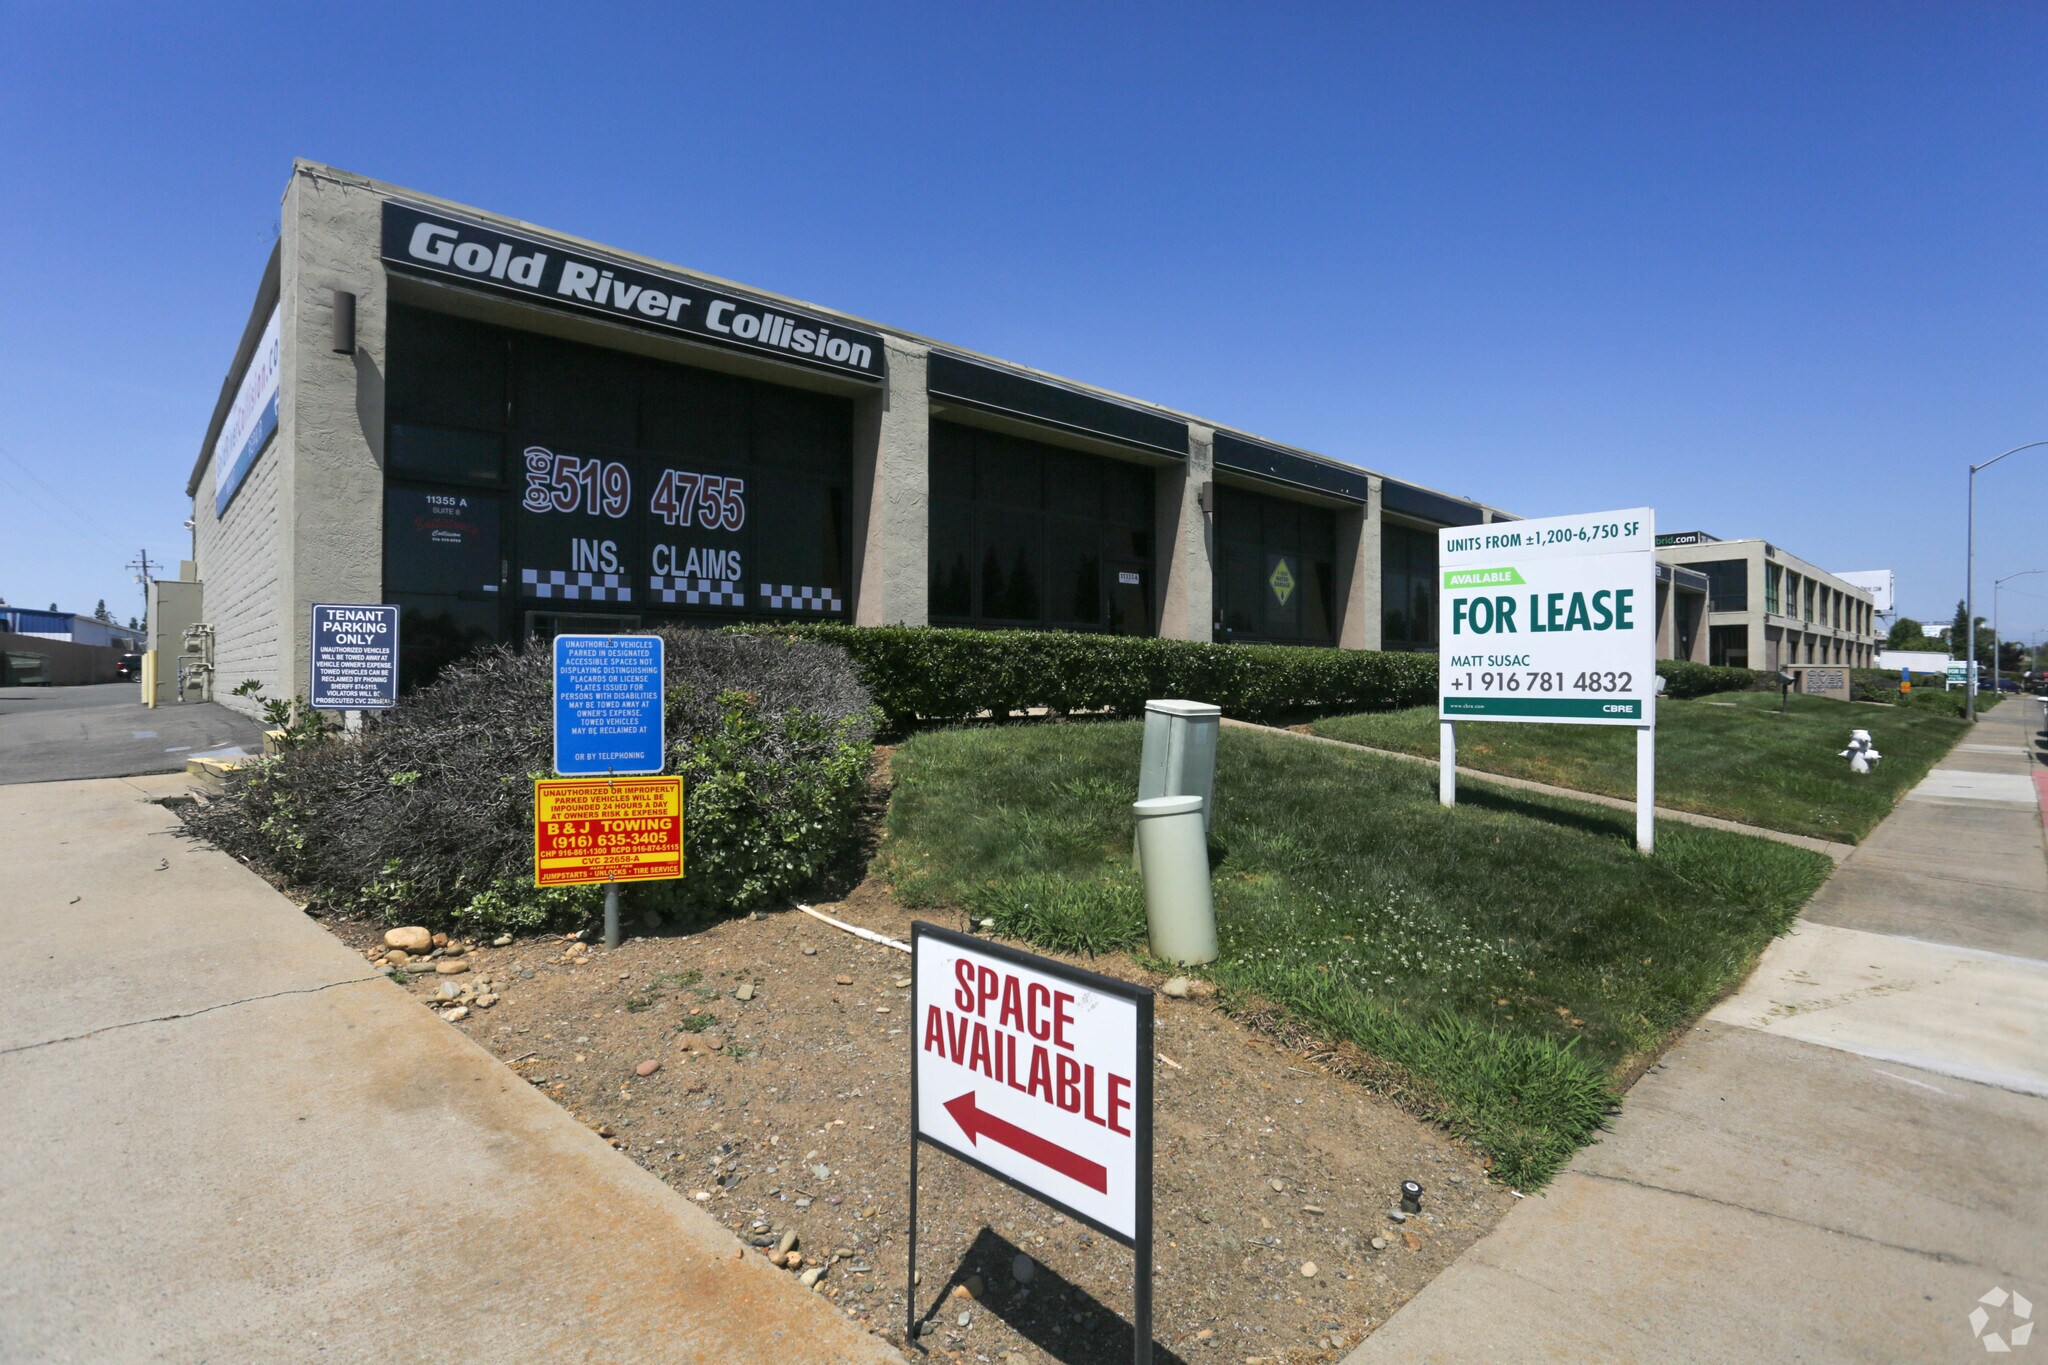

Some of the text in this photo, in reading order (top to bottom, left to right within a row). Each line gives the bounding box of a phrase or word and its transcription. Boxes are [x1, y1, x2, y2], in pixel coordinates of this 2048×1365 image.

[409, 222, 872, 369] Gold River Collision
[523, 446, 745, 531] (916) 519 4755
[426, 495, 467, 507] 11355 A
[433, 507, 453, 515] SUITE
[1447, 522, 1639, 552] UNITS FROM ±1,200-6,750 SF
[572, 538, 741, 581] INS. CLAIMS
[1450, 572, 1511, 585] AVAILABLE
[327, 610, 384, 621] TENANT
[1453, 589, 1633, 634] FOR LEASE
[323, 622, 387, 633] PARKING
[336, 634, 374, 644] ONLY
[1451, 655, 1530, 667] MATT SUSAC
[1451, 672, 1632, 692] +1 916 781 4832
[544, 788, 608, 796] UNAUTHORIZED
[551, 804, 600, 812] IMPOUNDED
[548, 818, 672, 834] B & J TOWING
[552, 832, 667, 848] (916) 635-3405
[632, 844, 679, 852] 916-874-5115
[542, 871, 587, 880] JUMPSTARTS
[924, 959, 1131, 1138] SPACE AVAILABLE
